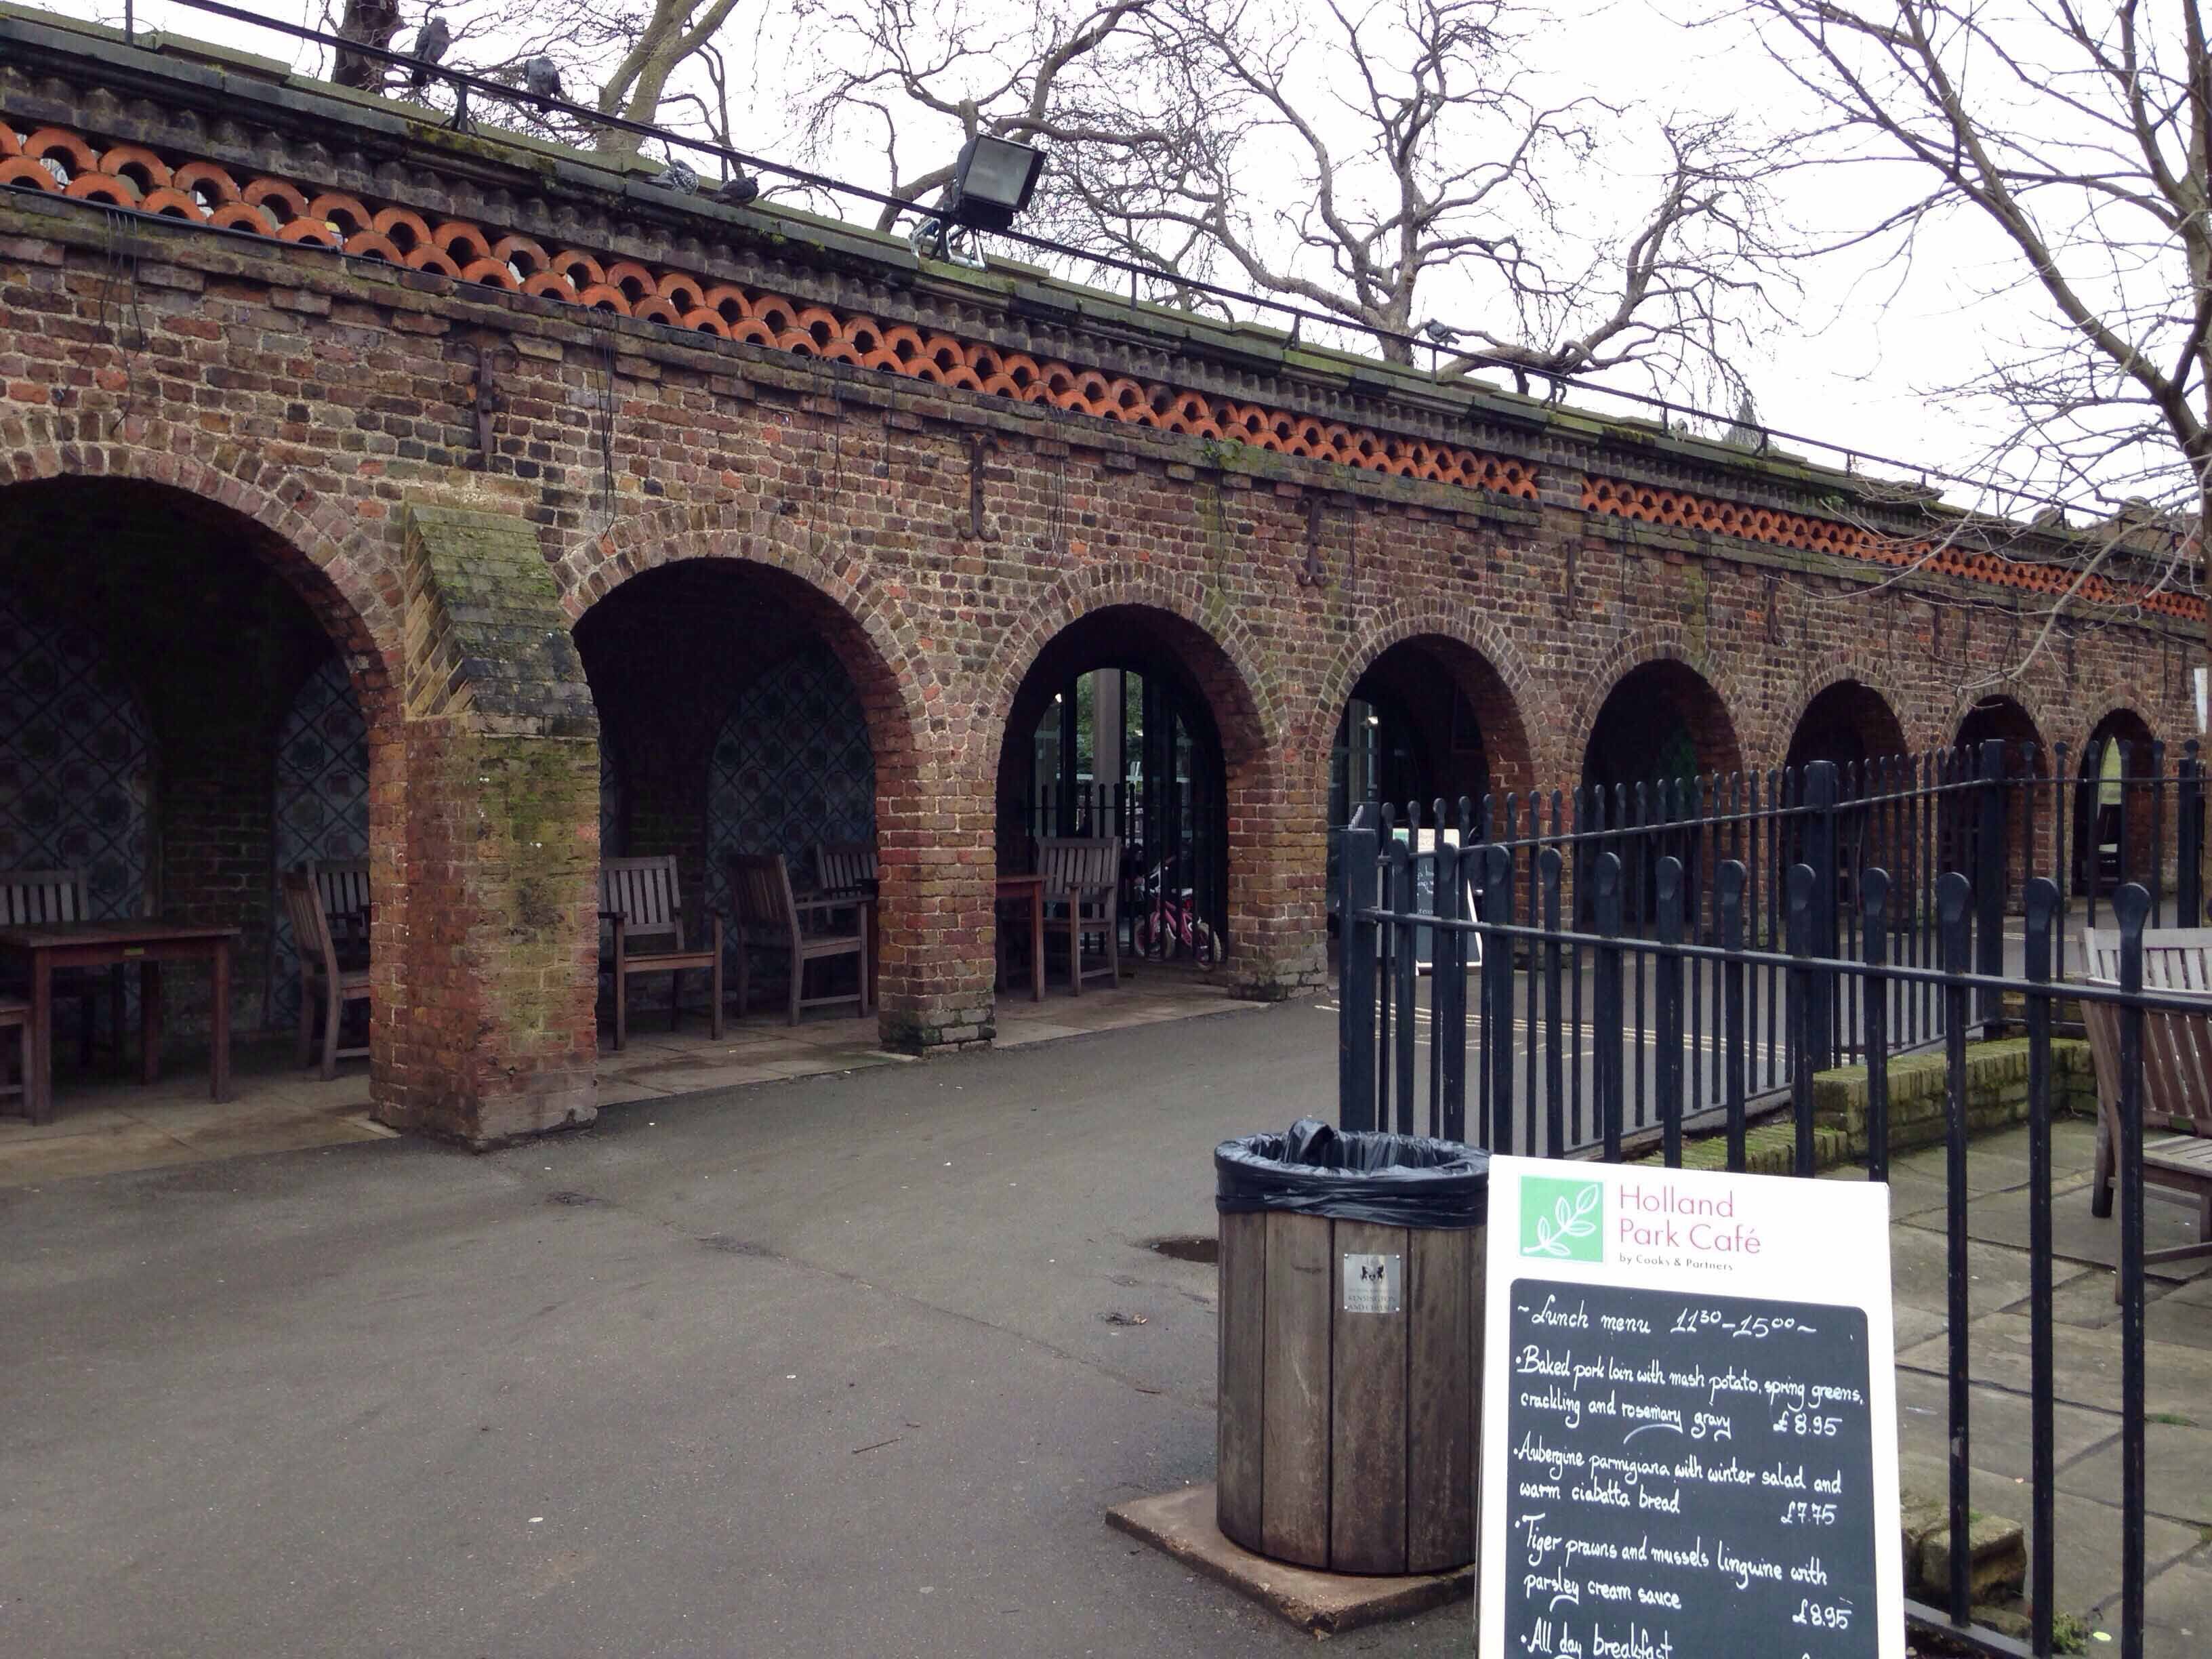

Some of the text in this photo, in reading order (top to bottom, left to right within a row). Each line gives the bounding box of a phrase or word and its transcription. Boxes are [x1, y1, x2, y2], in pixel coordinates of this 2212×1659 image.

[1620, 1184, 1733, 1217] Holland
[1620, 1218, 1761, 1254] Park Café
[1620, 1252, 1733, 1271] by Cooks & Partners
[1601, 1315, 1652, 1334] menu
[1517, 1345, 1571, 1376] Baked
[1574, 1355, 1604, 1391] pork
[1609, 1356, 1633, 1382] loin
[1637, 1358, 1666, 1385] with
[1669, 1364, 1705, 1387] mash
[1764, 1376, 1805, 1412] spring
[1521, 1384, 1580, 1429] crackling
[1588, 1389, 1616, 1415] and
[1621, 1404, 1683, 1444] rosemary
[1691, 1412, 1732, 1441] gravy
[1518, 1431, 1842, 1494] Aubergine parmigiana with winter salad and
[1519, 1475, 1837, 1525] warm ciabatta bread £7.75
[1522, 1513, 1828, 1590] Tiger prawns and mussels linguine with
[1524, 1566, 1852, 1629] parsley cream sauce £8.95
[1528, 1616, 1673, 1659] All day breakfast
